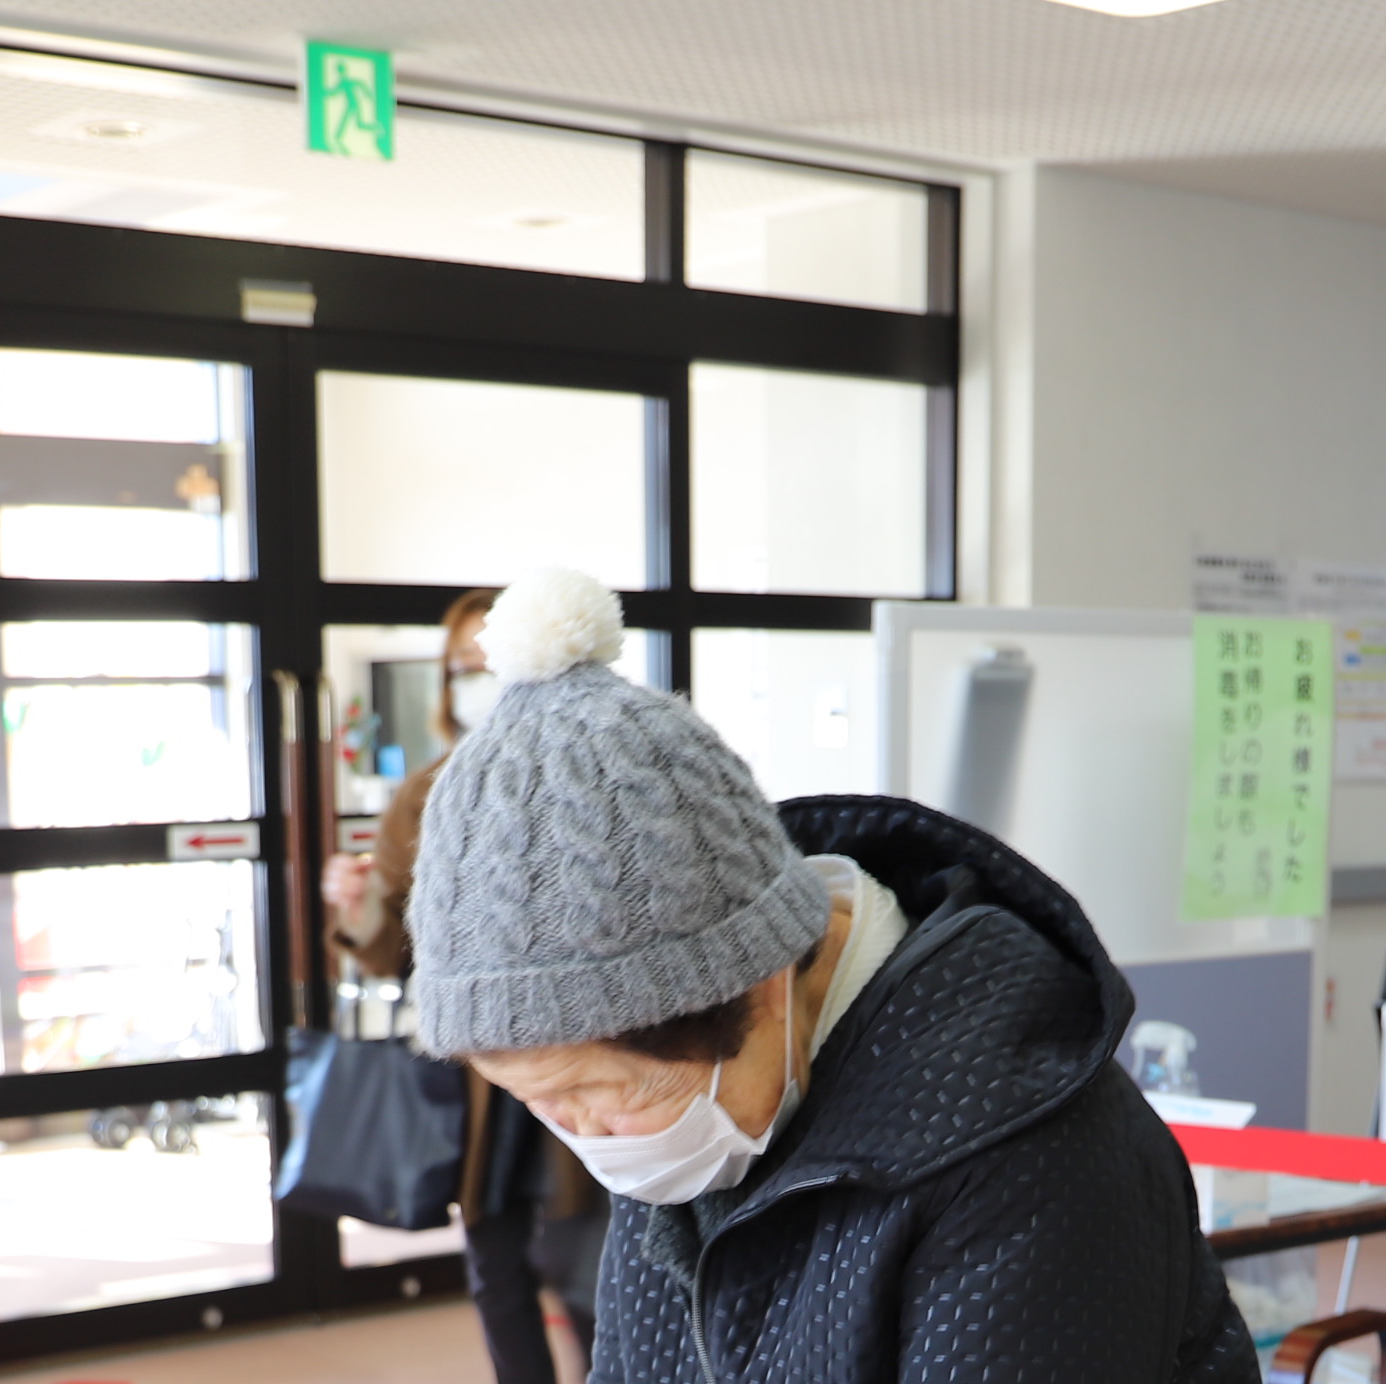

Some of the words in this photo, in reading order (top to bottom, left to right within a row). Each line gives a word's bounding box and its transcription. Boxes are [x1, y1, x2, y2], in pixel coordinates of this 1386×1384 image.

[1282, 636, 1315, 885] お疲れ様でした
